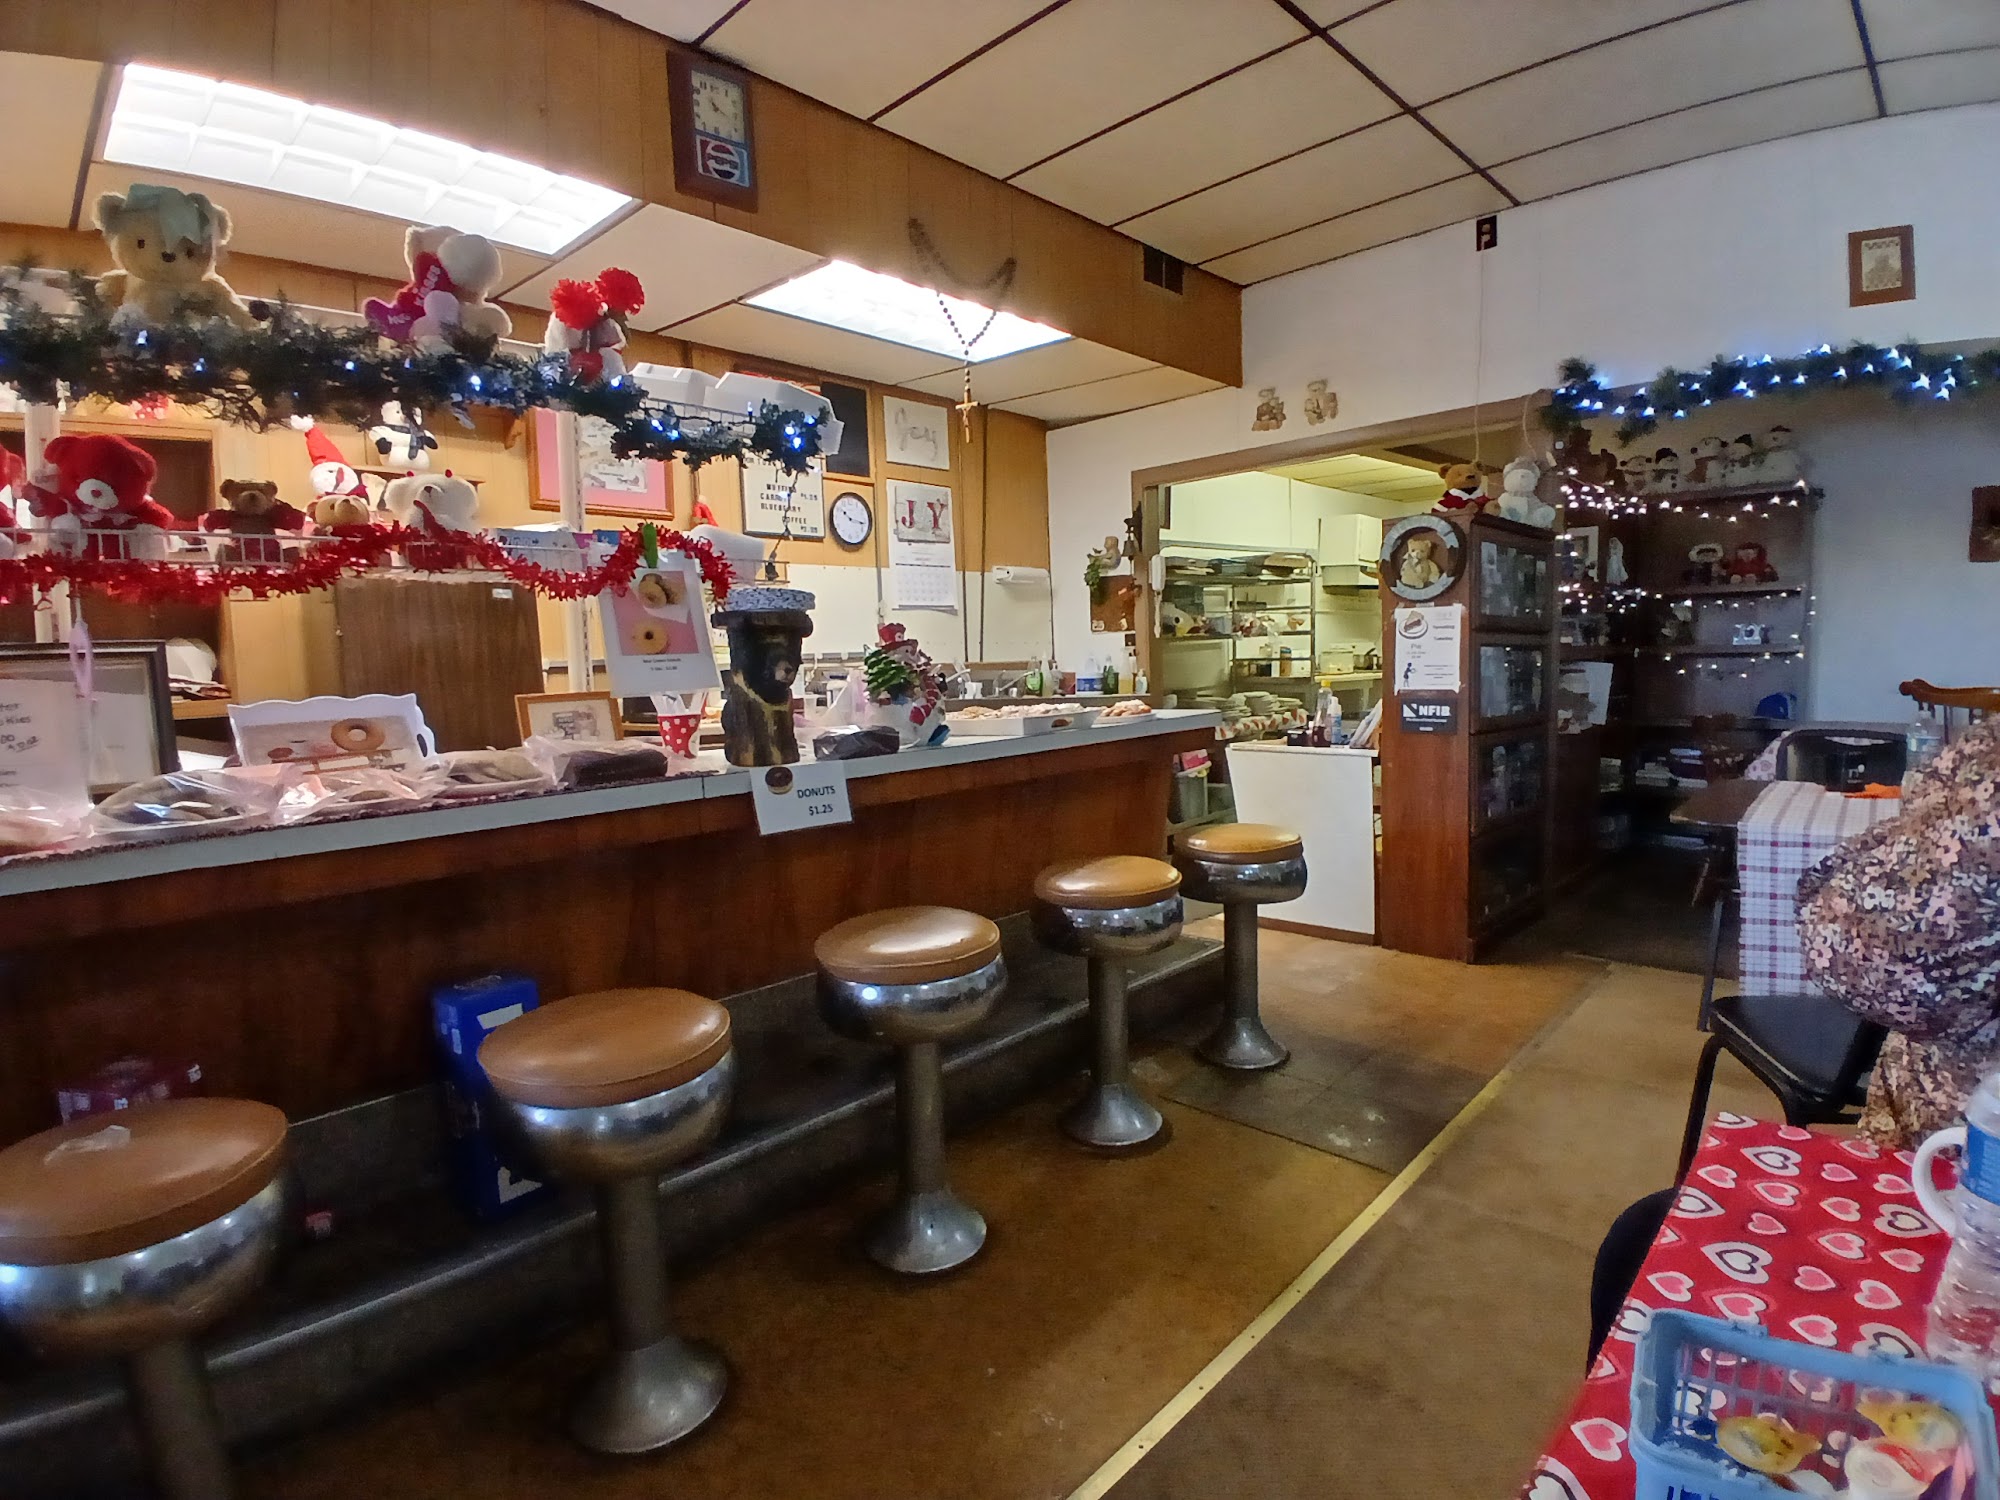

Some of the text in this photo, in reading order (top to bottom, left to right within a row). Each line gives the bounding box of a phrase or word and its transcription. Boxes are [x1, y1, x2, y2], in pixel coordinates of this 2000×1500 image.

[1418, 705, 1451, 717] NFIB
[797, 785, 836, 799] DONUTS
[808, 803, 834, 816] $1.25
